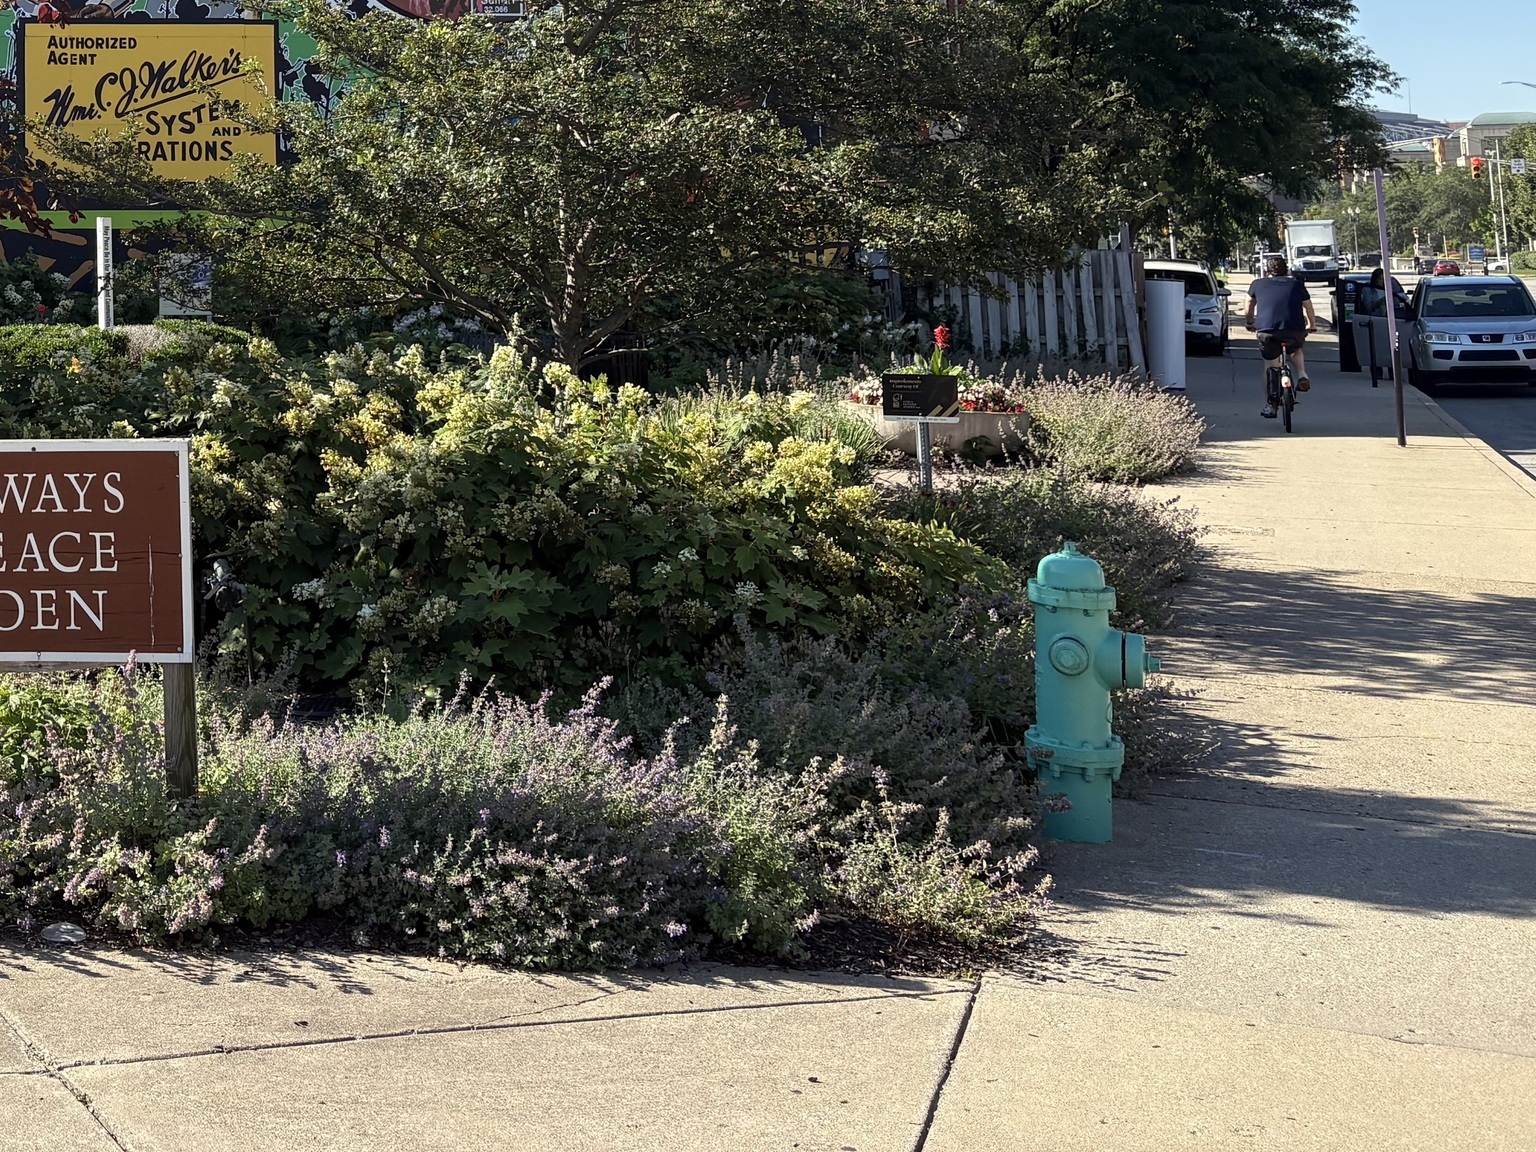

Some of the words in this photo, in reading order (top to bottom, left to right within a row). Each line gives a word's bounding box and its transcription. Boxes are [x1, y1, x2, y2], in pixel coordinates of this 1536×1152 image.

[47, 35, 137, 49] AUTHORIZED
[47, 51, 97, 65] AGENT
[139, 48, 242, 99] Walker's
[212, 126, 242, 136] AND
